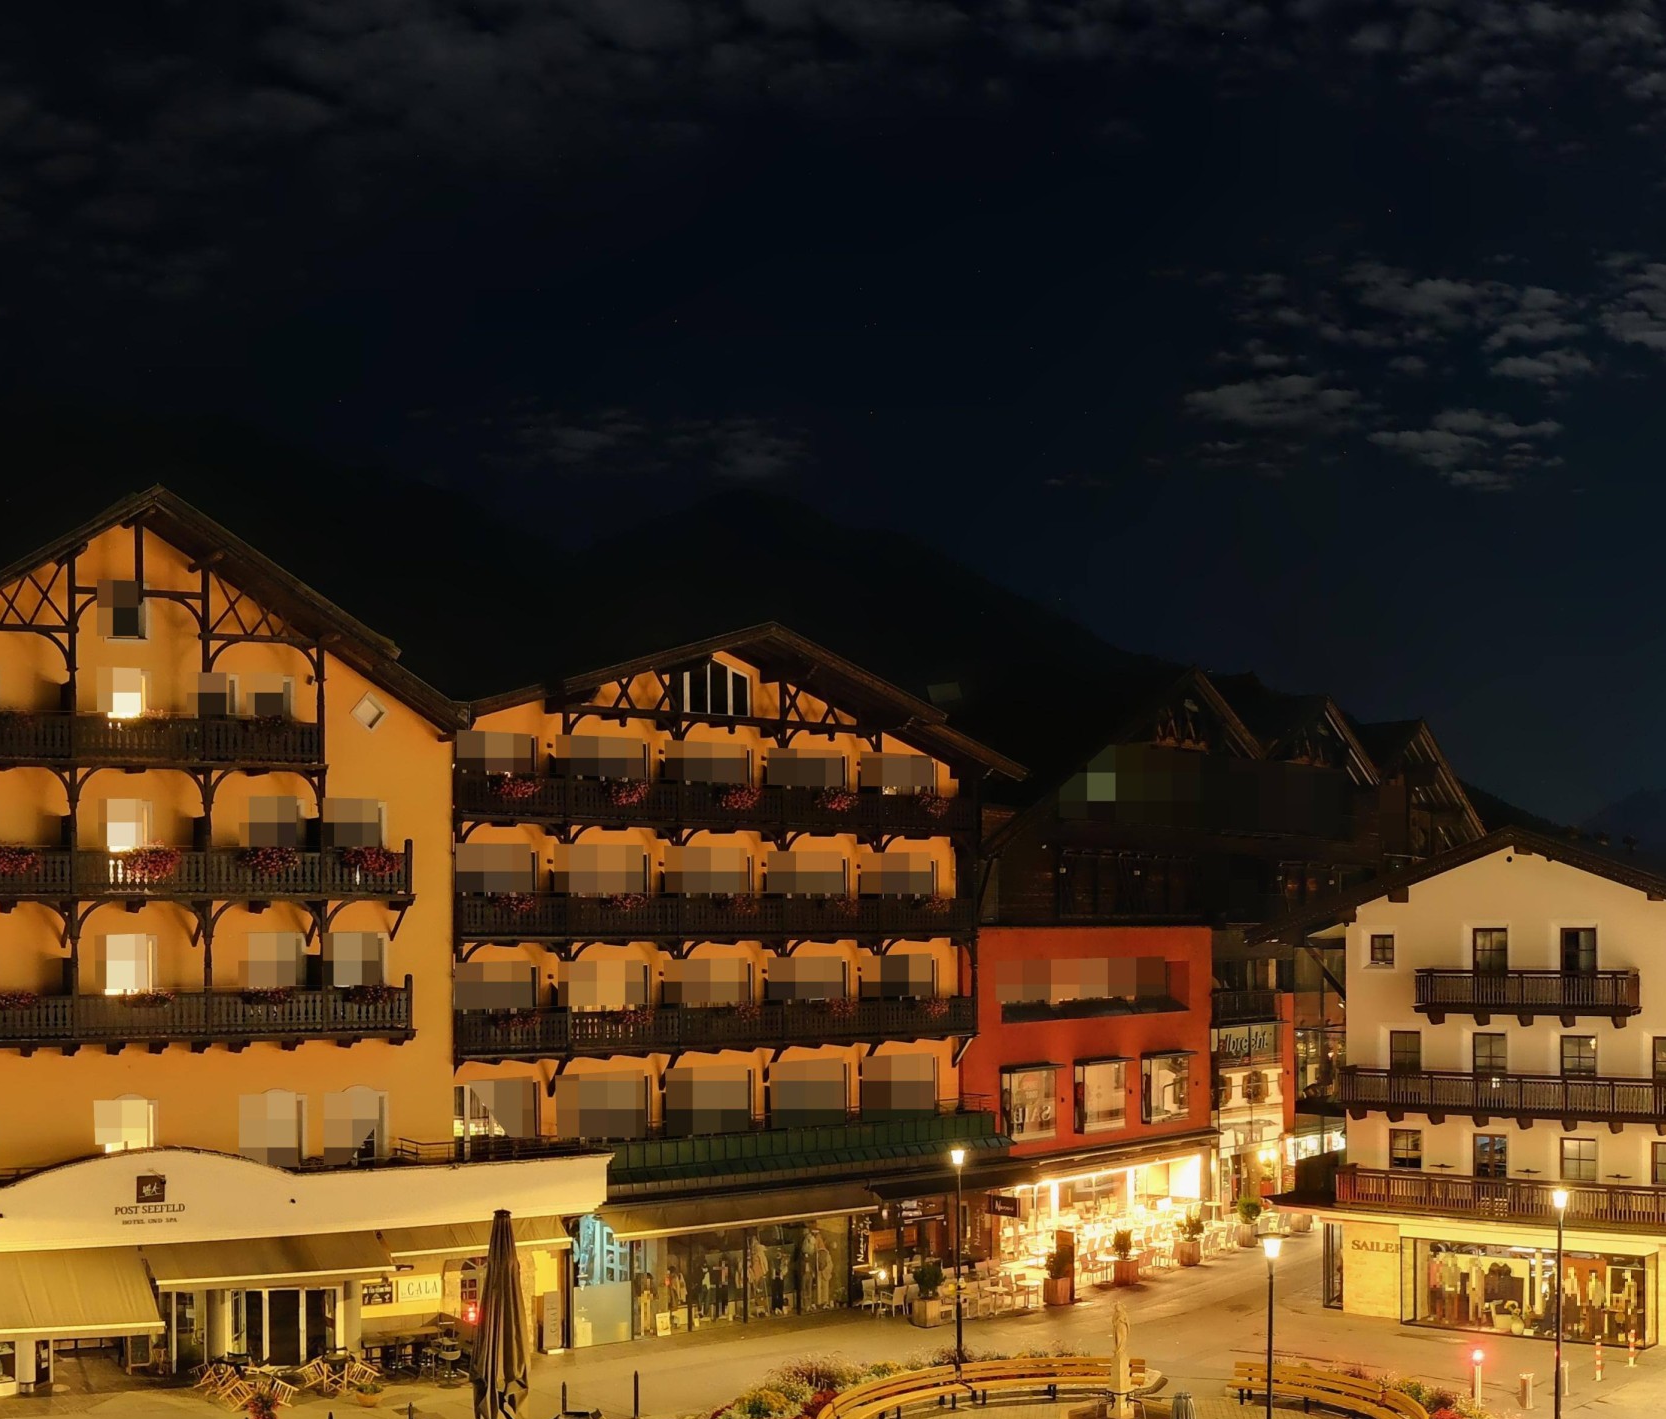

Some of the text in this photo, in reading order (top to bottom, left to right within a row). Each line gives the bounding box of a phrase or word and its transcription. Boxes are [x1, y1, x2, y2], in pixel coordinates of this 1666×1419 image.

[114, 1203, 186, 1215] POST SEEFELD
[408, 1280, 438, 1296] CALA
